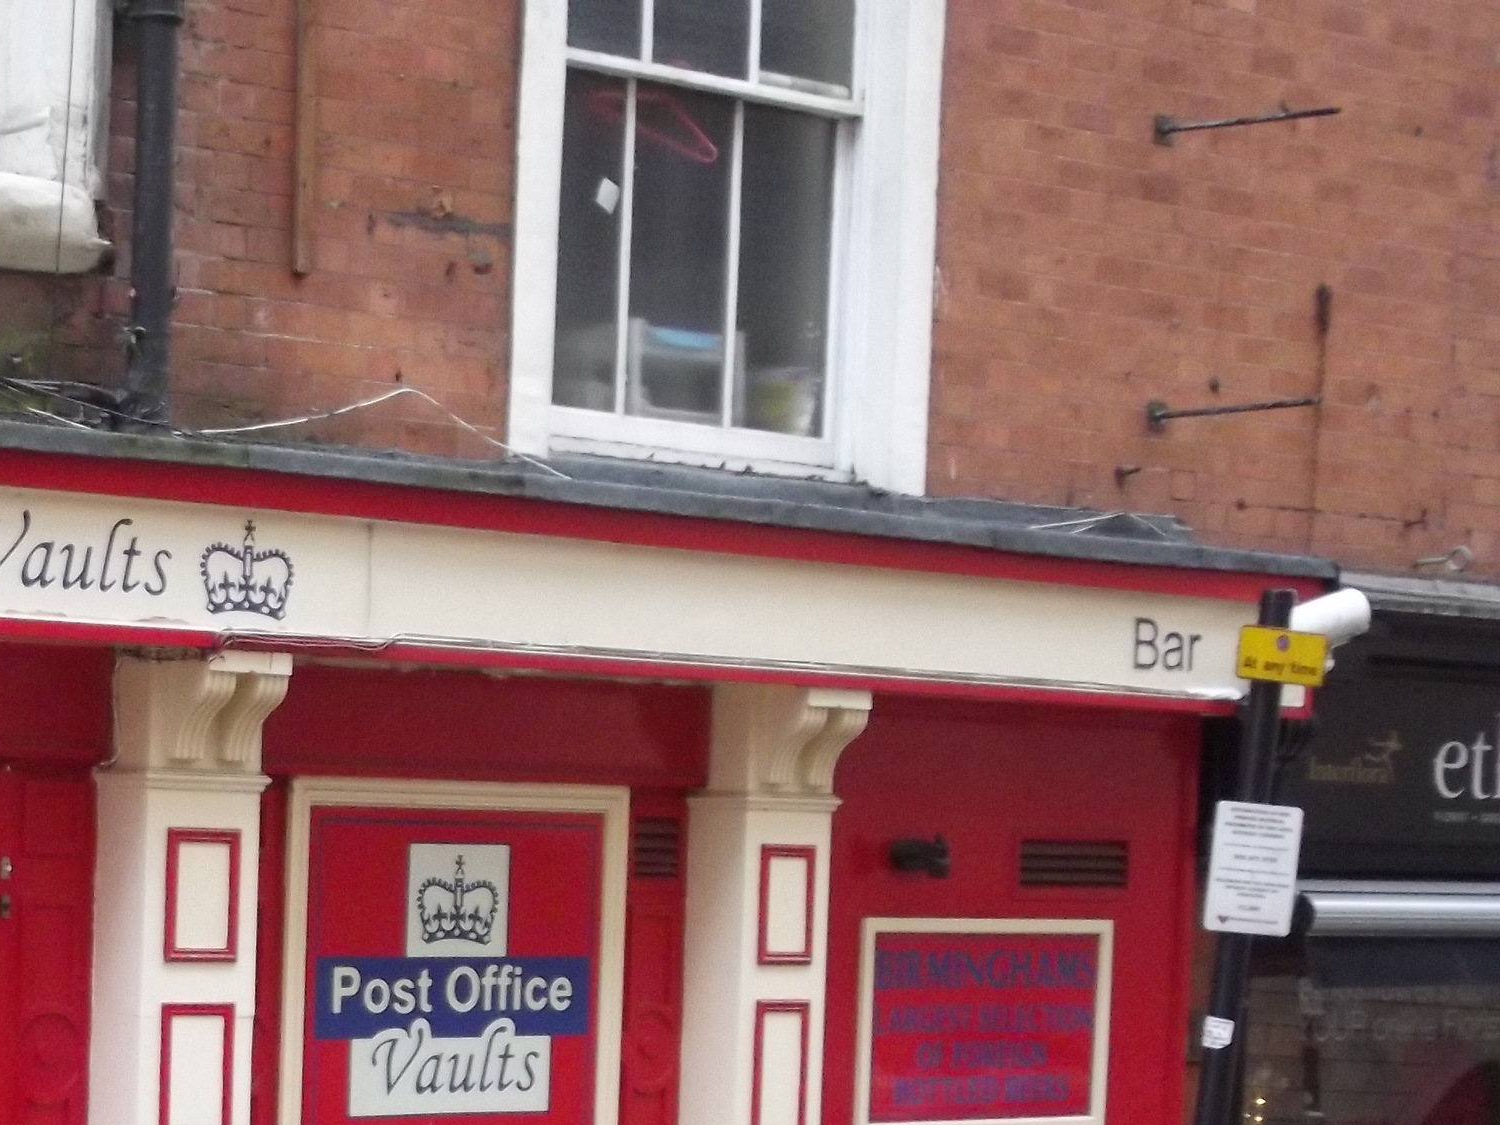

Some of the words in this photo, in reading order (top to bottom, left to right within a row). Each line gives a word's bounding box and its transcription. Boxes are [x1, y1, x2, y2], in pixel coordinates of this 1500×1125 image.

[1133, 616, 1203, 673] Bar
[1263, 660, 1286, 676] any
[1290, 661, 1318, 677] time
[331, 965, 434, 1015] Post
[445, 963, 574, 1014] Office
[873, 1003, 971, 1034] LARGEST
[977, 1003, 1095, 1033] SELECTION
[370, 1026, 541, 1097] Vaults
[916, 1040, 945, 1069] OF
[952, 1040, 1048, 1068] FOREIGN
[893, 1075, 999, 1105] BOTTLED
[1004, 1073, 1070, 1103] BEERS
